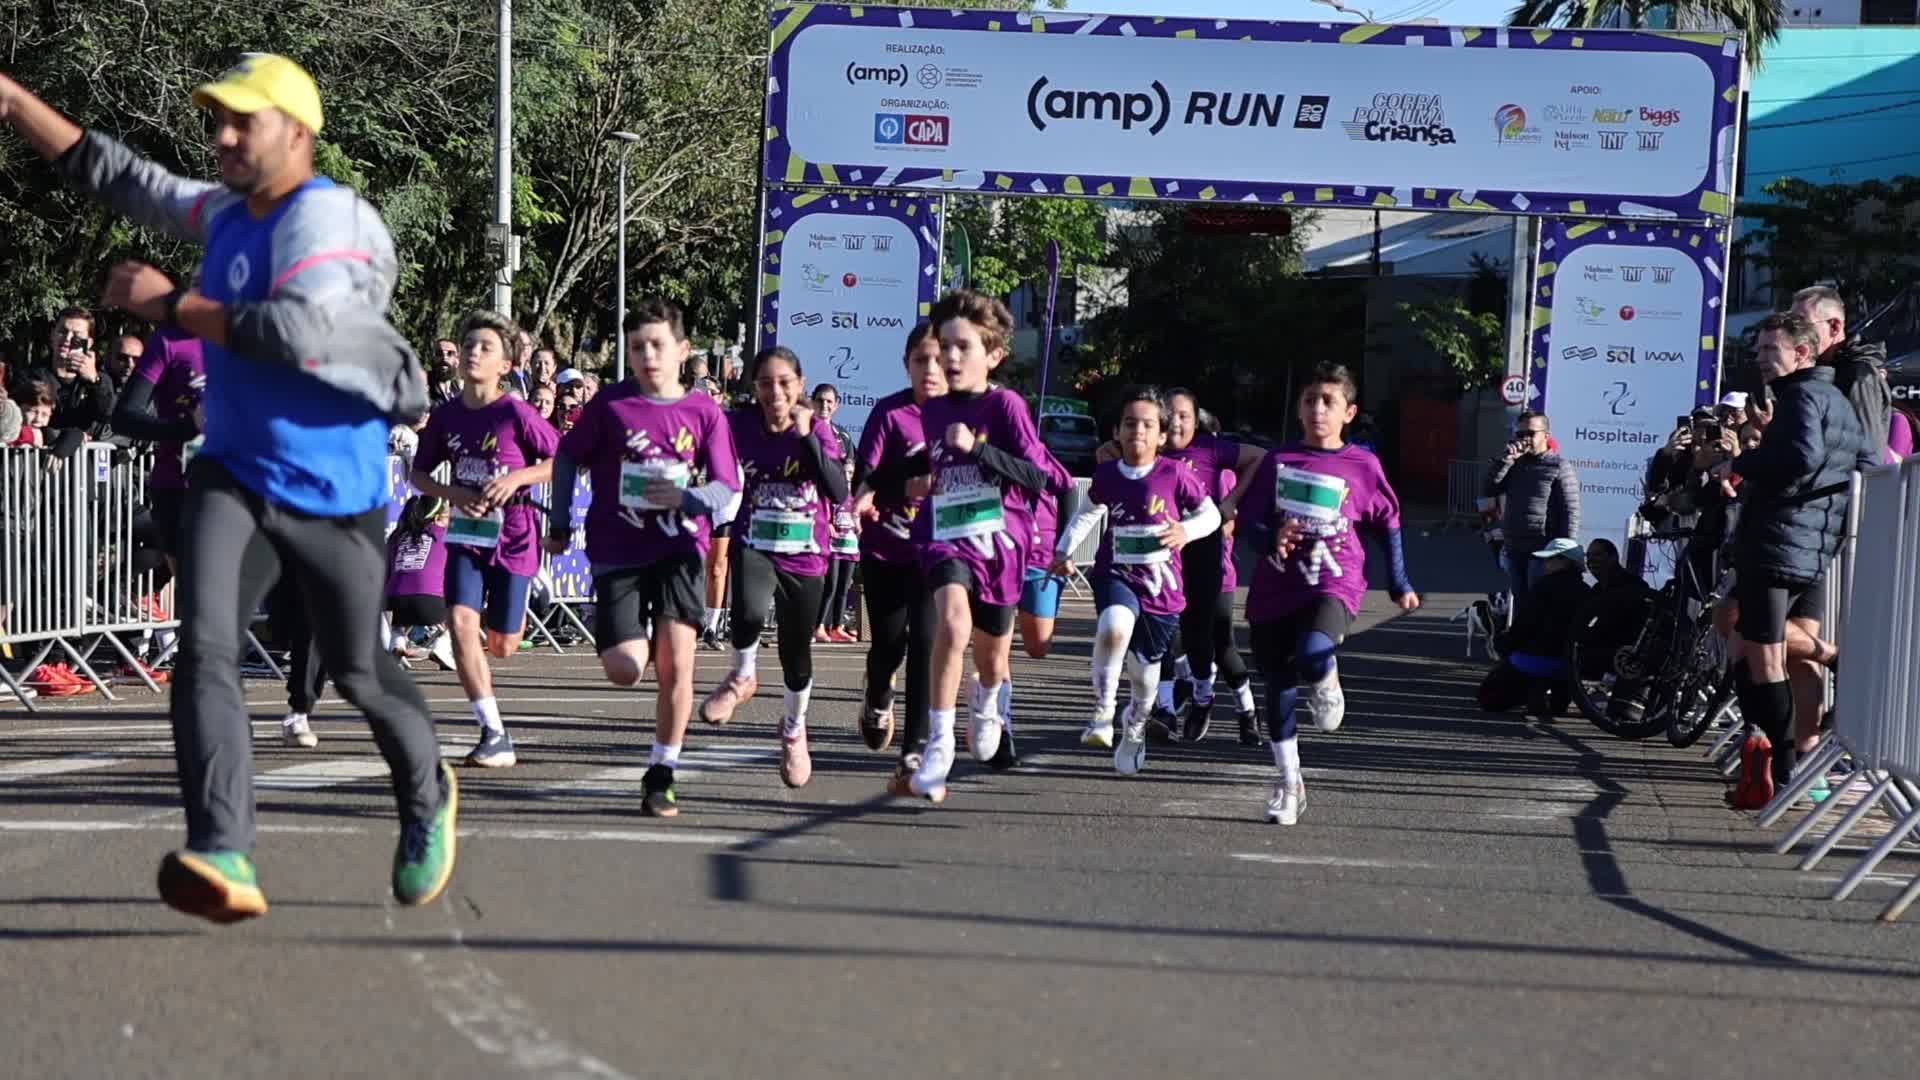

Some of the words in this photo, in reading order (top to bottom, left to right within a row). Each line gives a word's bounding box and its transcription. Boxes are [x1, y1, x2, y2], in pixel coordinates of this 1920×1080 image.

[886, 44, 945, 56] REALIZAÇÃO:
[846, 61, 908, 87] (amp)
[880, 98, 950, 111] ORGANIZAÇÃO:
[1027, 75, 1171, 136] (amp)
[1184, 91, 1285, 127] RUN
[908, 119, 944, 143] CAPA
[1364, 120, 1457, 147] Criança
[1598, 131, 1628, 150] TNT
[1506, 381, 1525, 392] 40
[1575, 427, 1660, 444] Hospitalar
